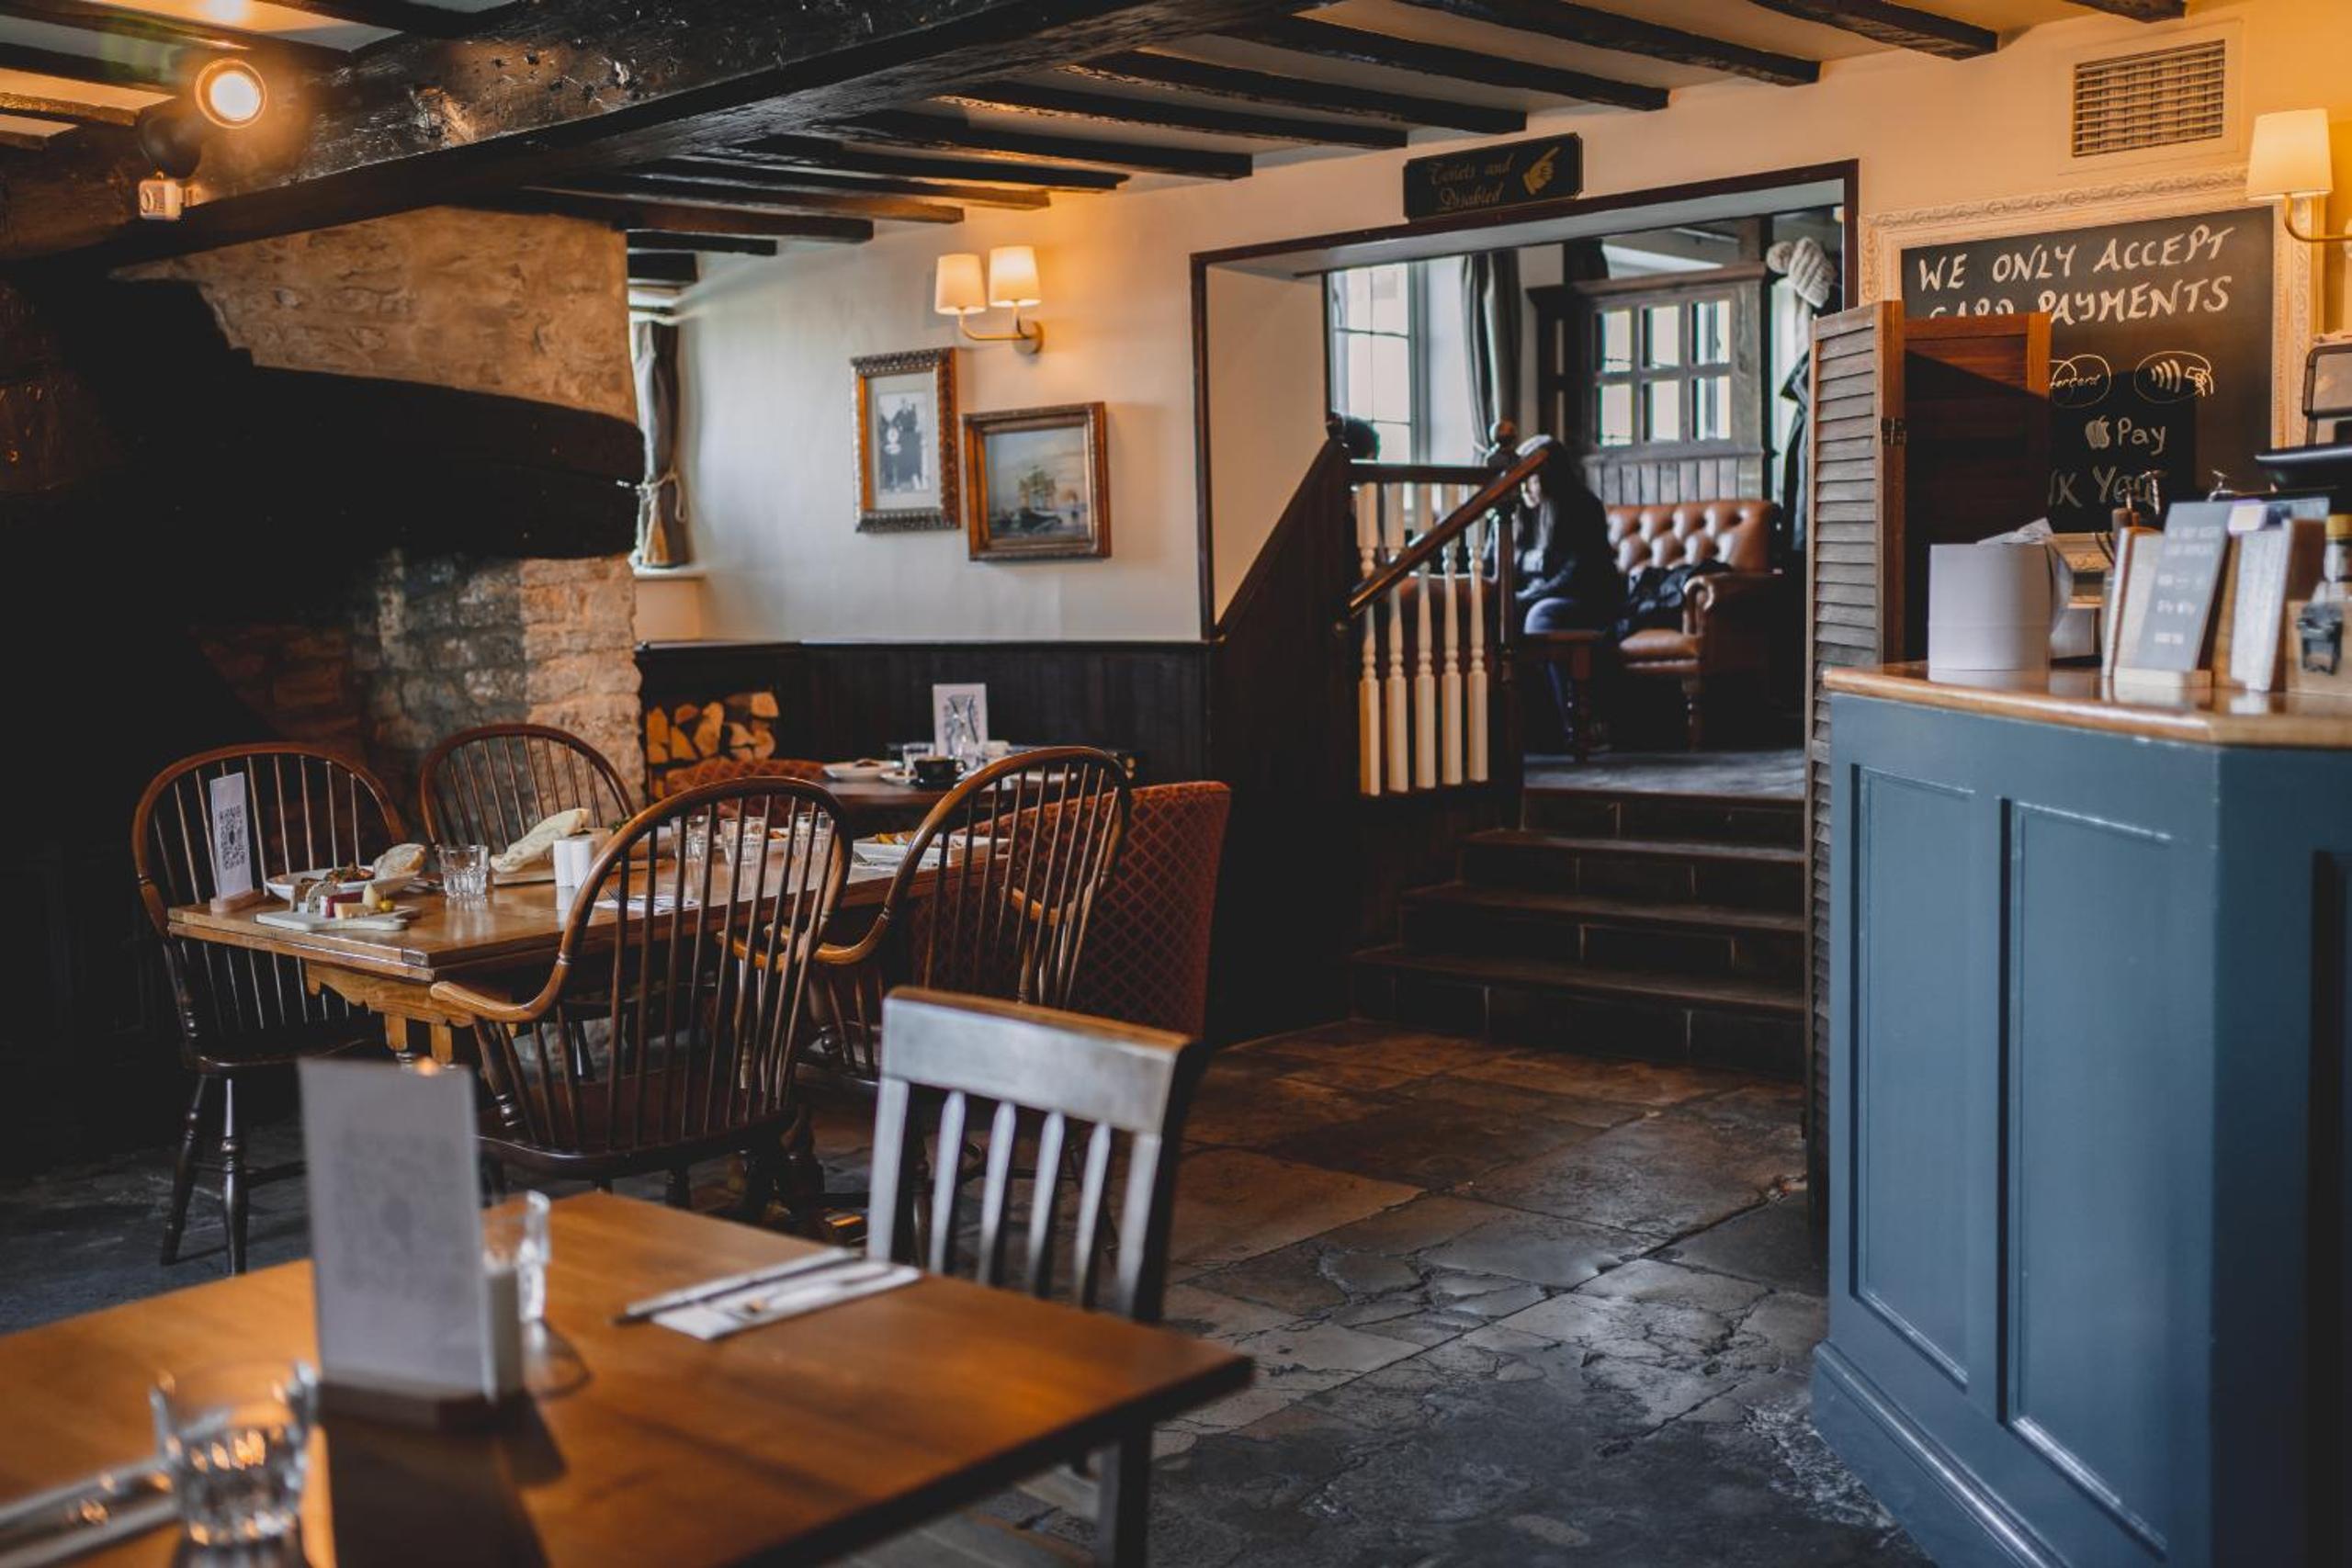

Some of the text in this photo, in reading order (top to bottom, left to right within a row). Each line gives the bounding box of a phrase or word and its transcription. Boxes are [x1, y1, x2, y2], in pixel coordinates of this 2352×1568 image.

[1484, 152, 1514, 175] and
[1918, 224, 2235, 292] WE ONLY ACCEPT
[2038, 276, 2233, 325] PAYMENTS
[2117, 416, 2166, 456] Pay
